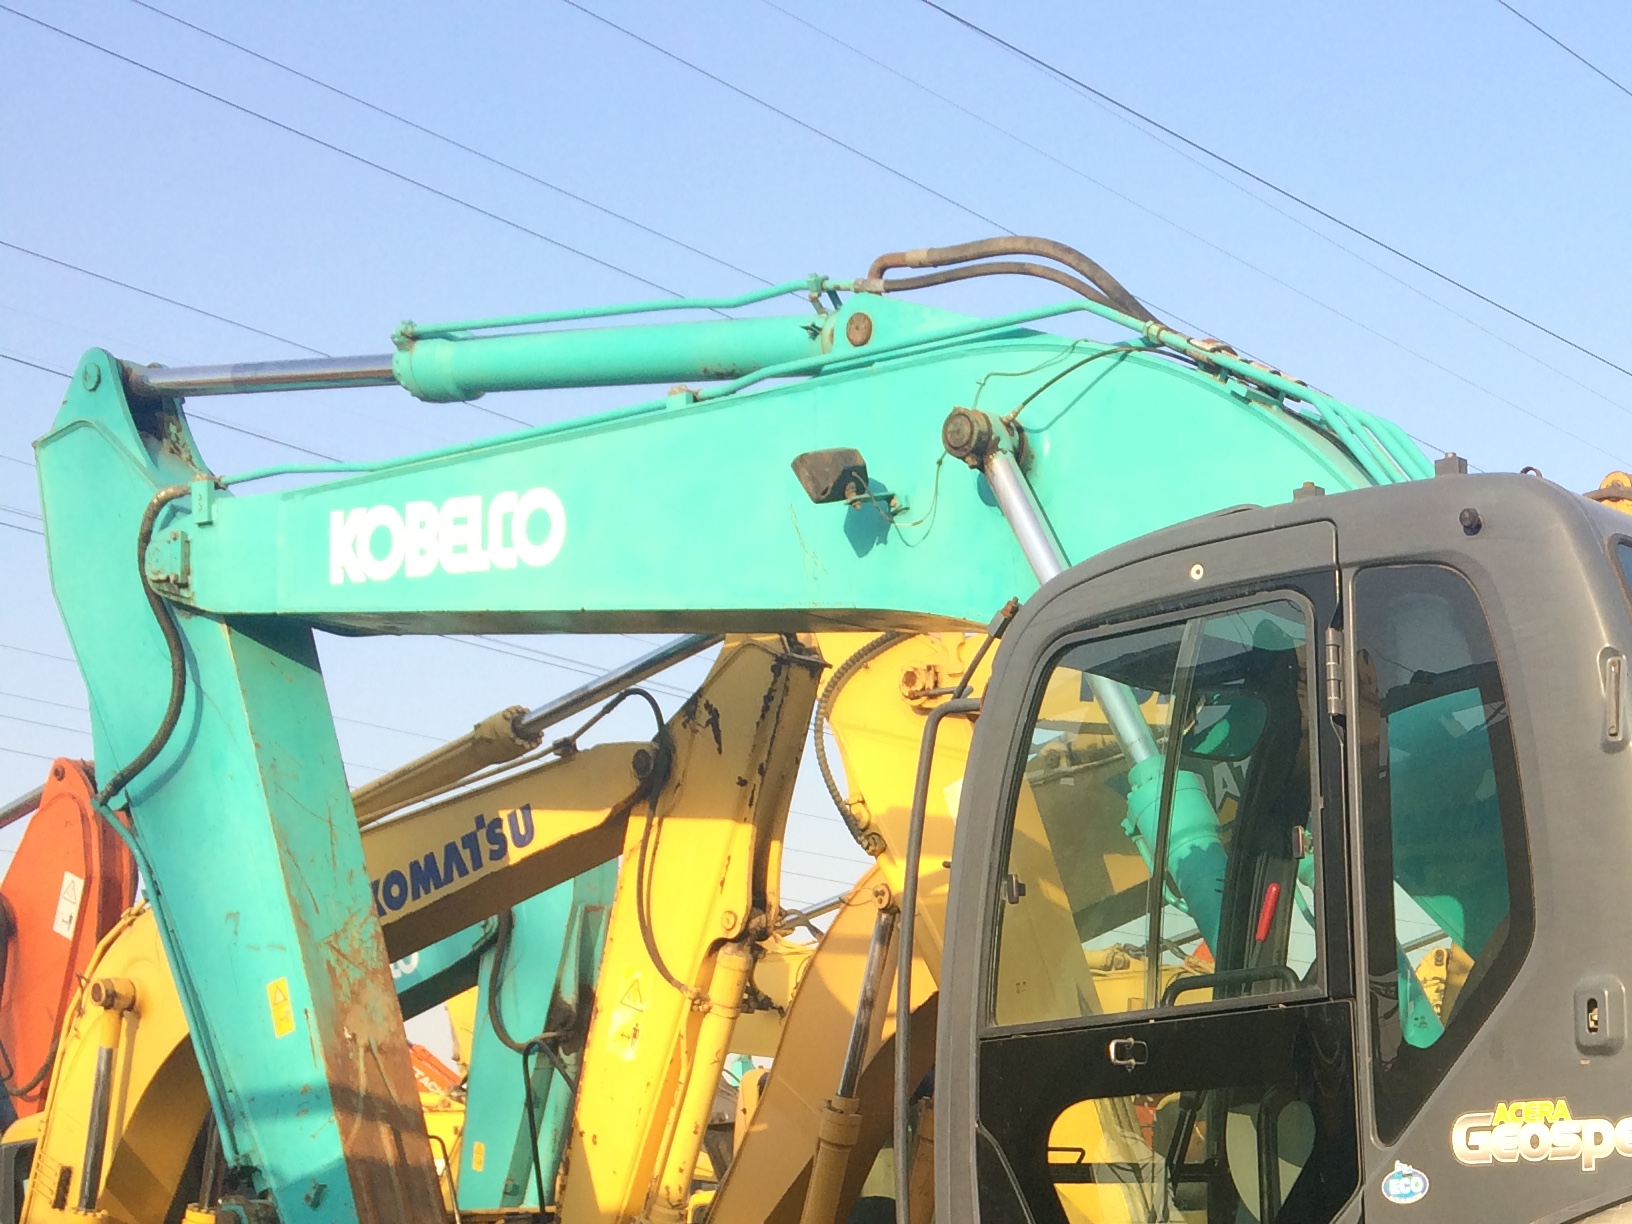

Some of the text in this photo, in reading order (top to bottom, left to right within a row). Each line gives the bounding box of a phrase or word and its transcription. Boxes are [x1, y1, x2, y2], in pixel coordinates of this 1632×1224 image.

[329, 486, 567, 586] KOBELCO
[1492, 1099, 1572, 1126] ACERA
[1389, 1176, 1424, 1195] ECO
